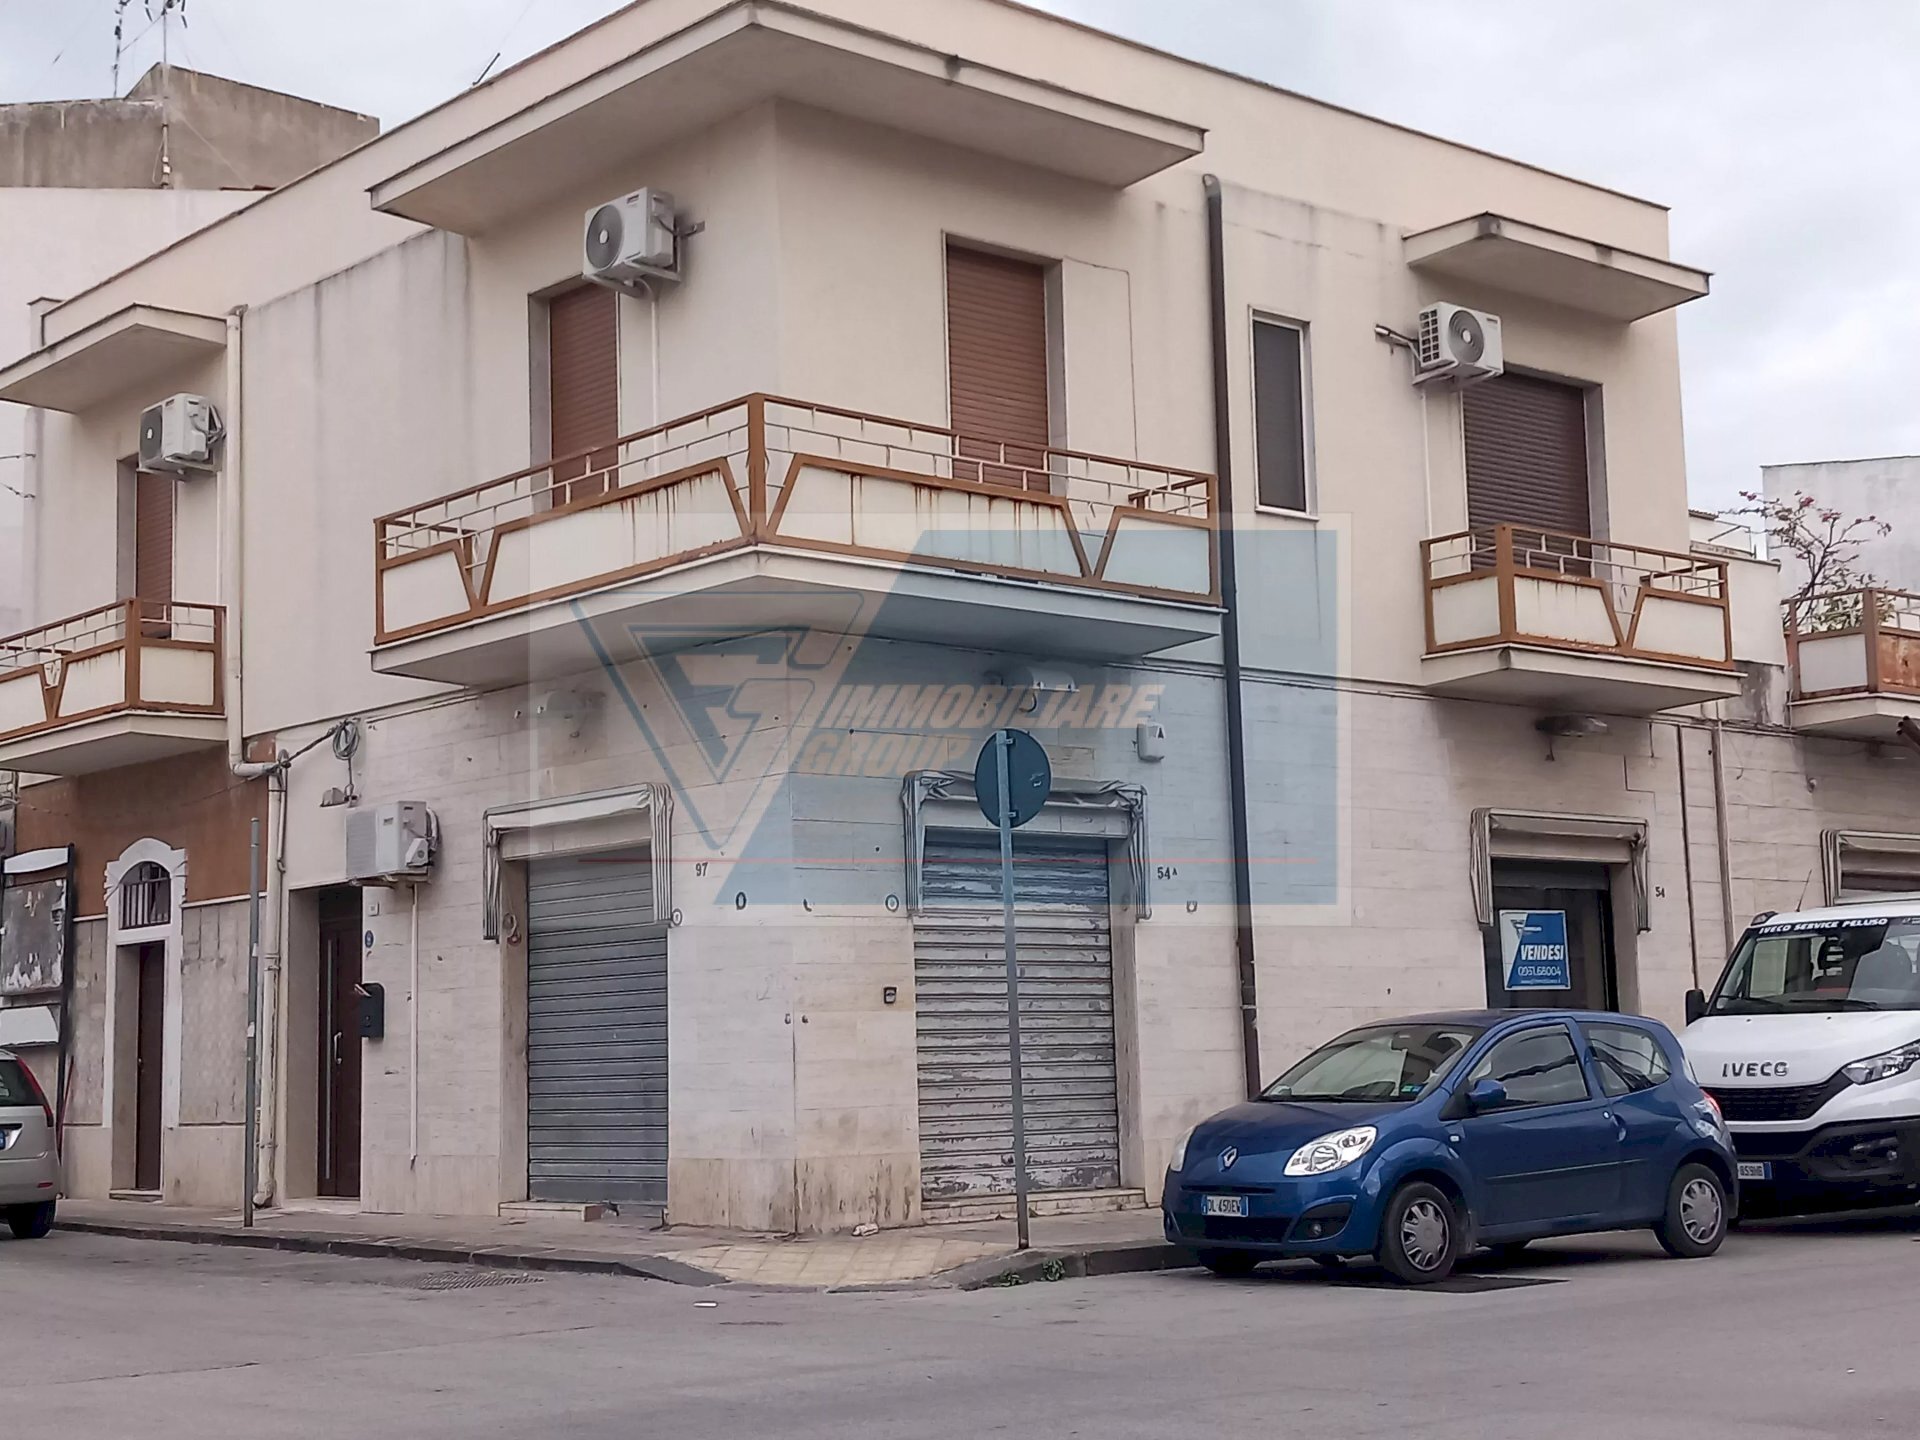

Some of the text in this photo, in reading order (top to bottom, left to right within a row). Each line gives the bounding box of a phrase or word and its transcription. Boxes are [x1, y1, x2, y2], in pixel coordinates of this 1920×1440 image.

[695, 862, 708, 877] 97
[1758, 924, 1791, 935] IVECO
[1794, 921, 1839, 931] SERVICE
[1520, 944, 1564, 961] VENDESI
[1721, 1061, 1788, 1078] IVECO
